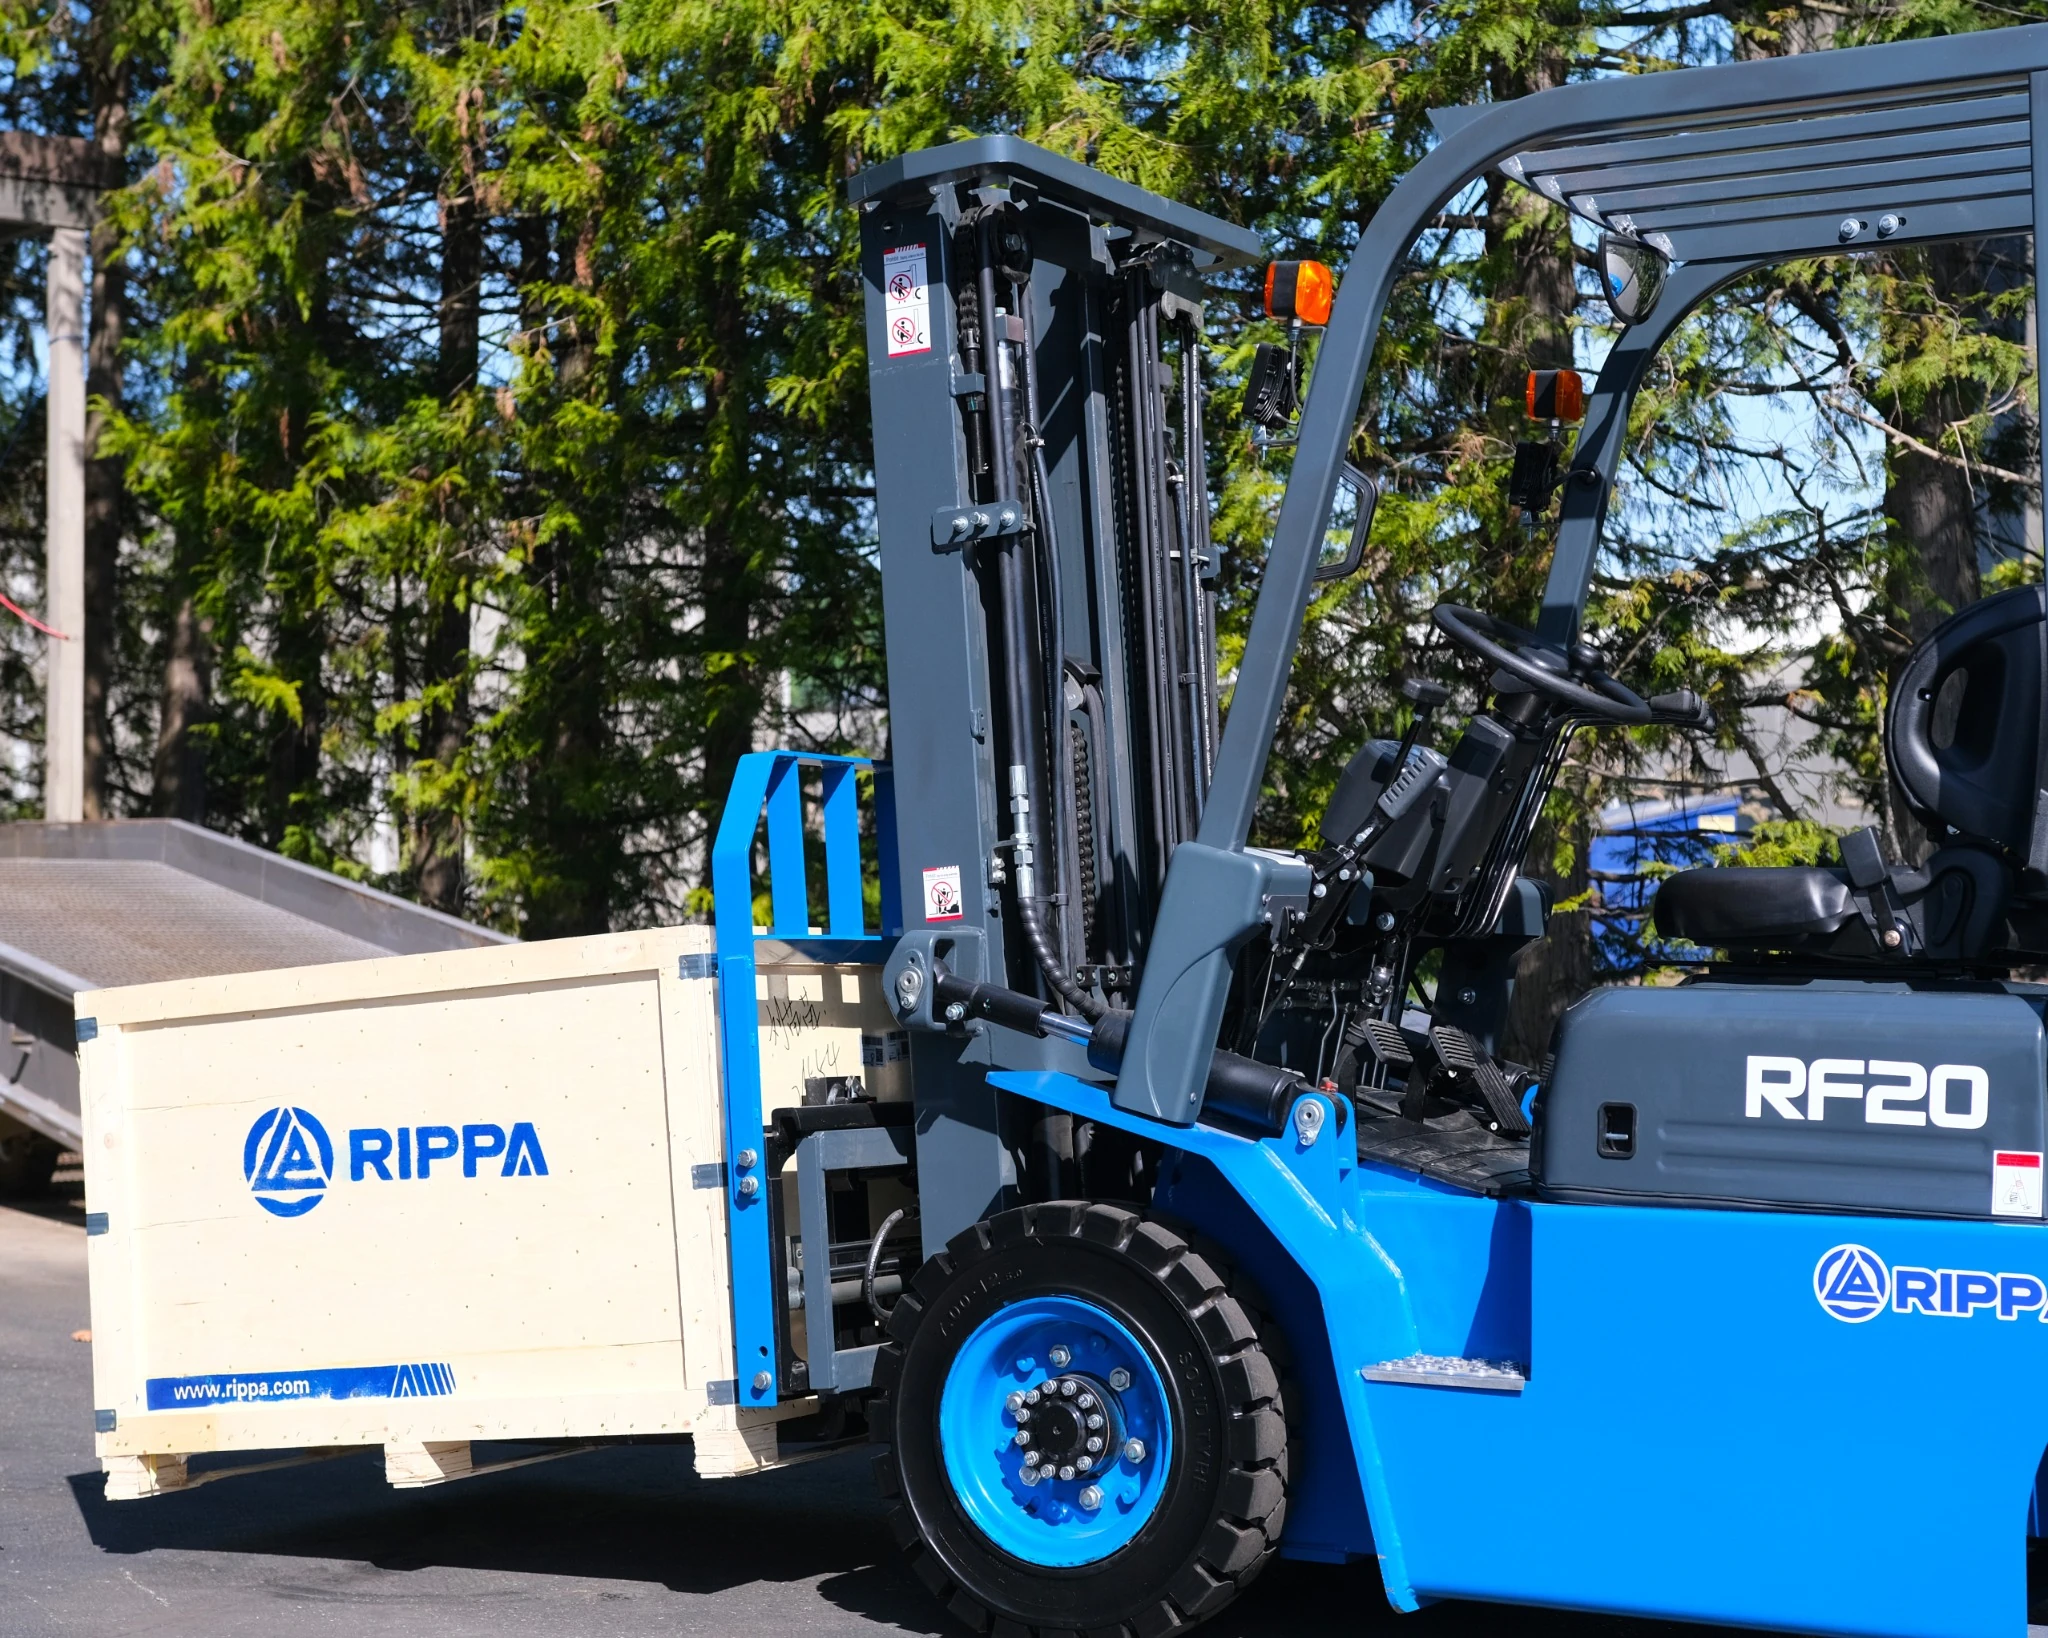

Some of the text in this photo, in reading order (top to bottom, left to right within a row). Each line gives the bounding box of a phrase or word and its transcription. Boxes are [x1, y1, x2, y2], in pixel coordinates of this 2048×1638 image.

[1745, 1055, 1989, 1130] RF20
[349, 1122, 549, 1182] RIPPA
[1892, 1265, 2048, 1323] RIPP
[173, 1378, 310, 1402] www.rippa.com
